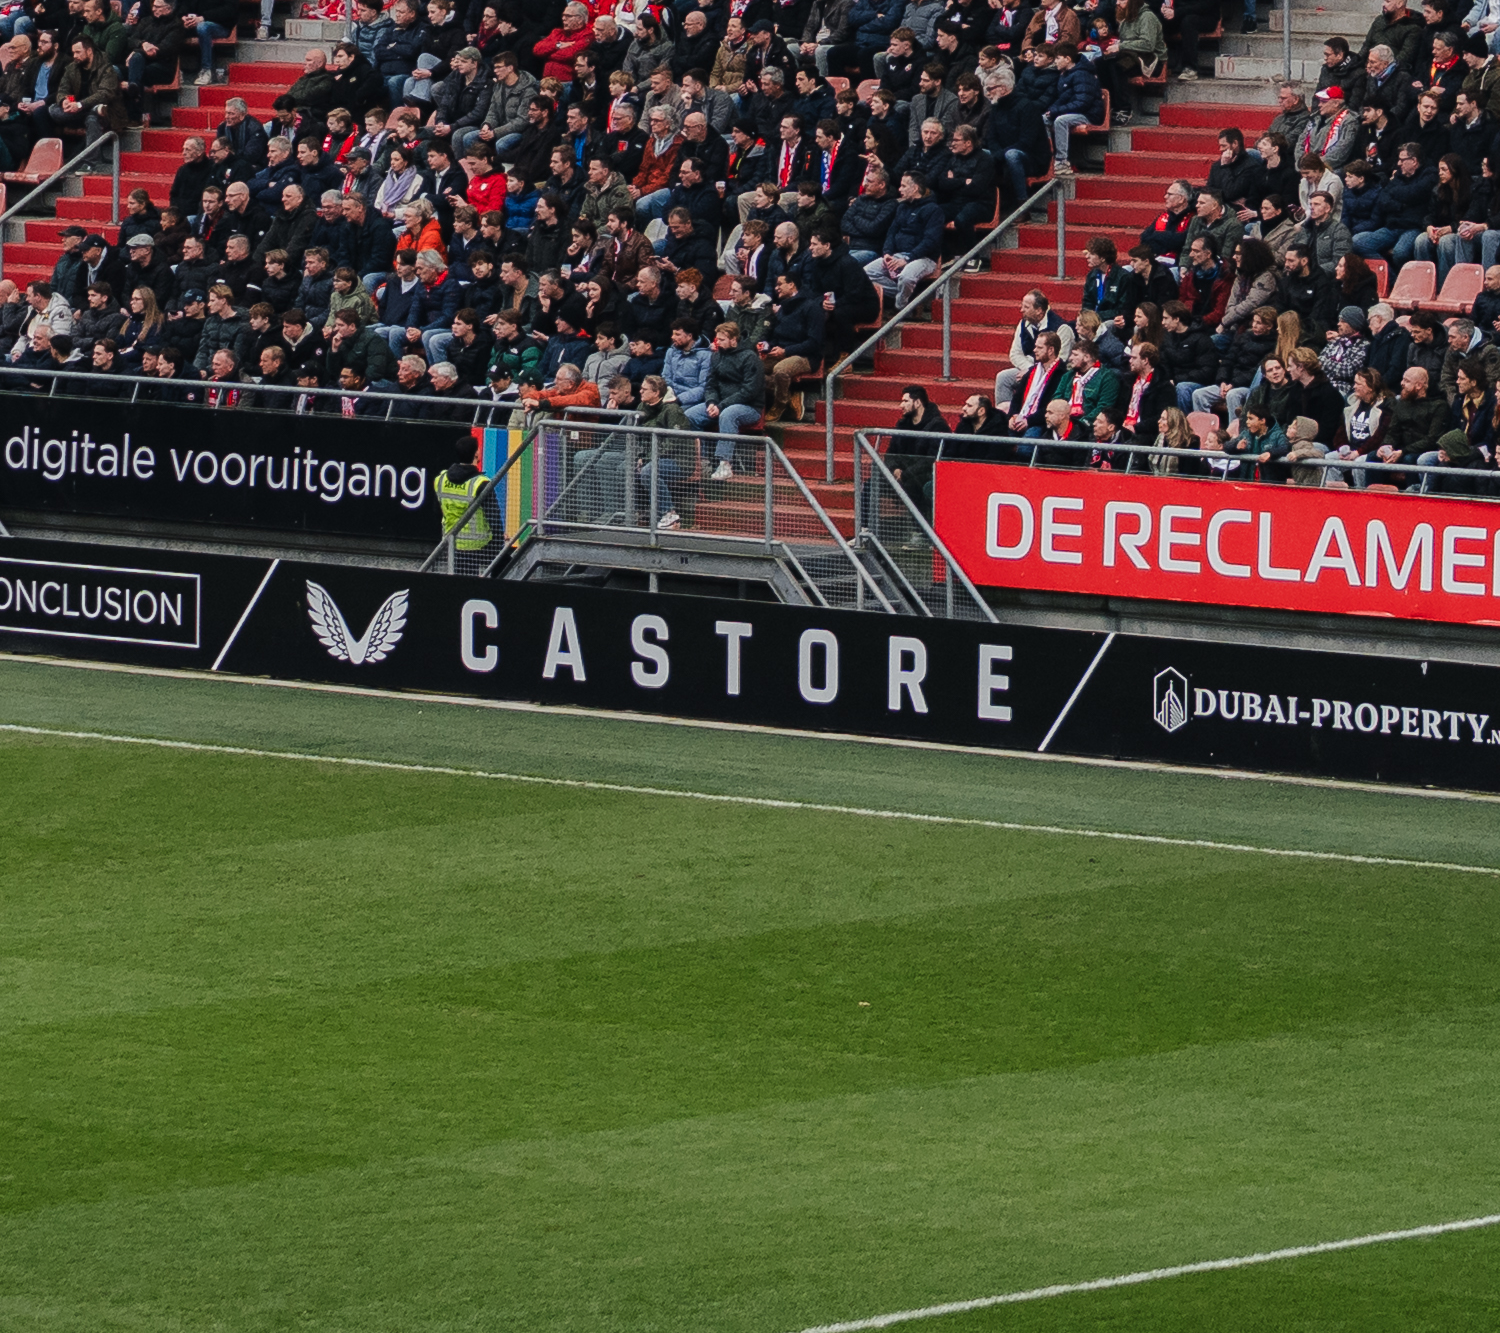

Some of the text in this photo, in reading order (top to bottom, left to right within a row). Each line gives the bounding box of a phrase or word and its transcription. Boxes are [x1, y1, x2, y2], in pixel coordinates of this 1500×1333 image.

[5, 425, 427, 510] digitale vooruitgang
[985, 491, 1084, 565] DE
[460, 597, 1014, 722] CASTORE
